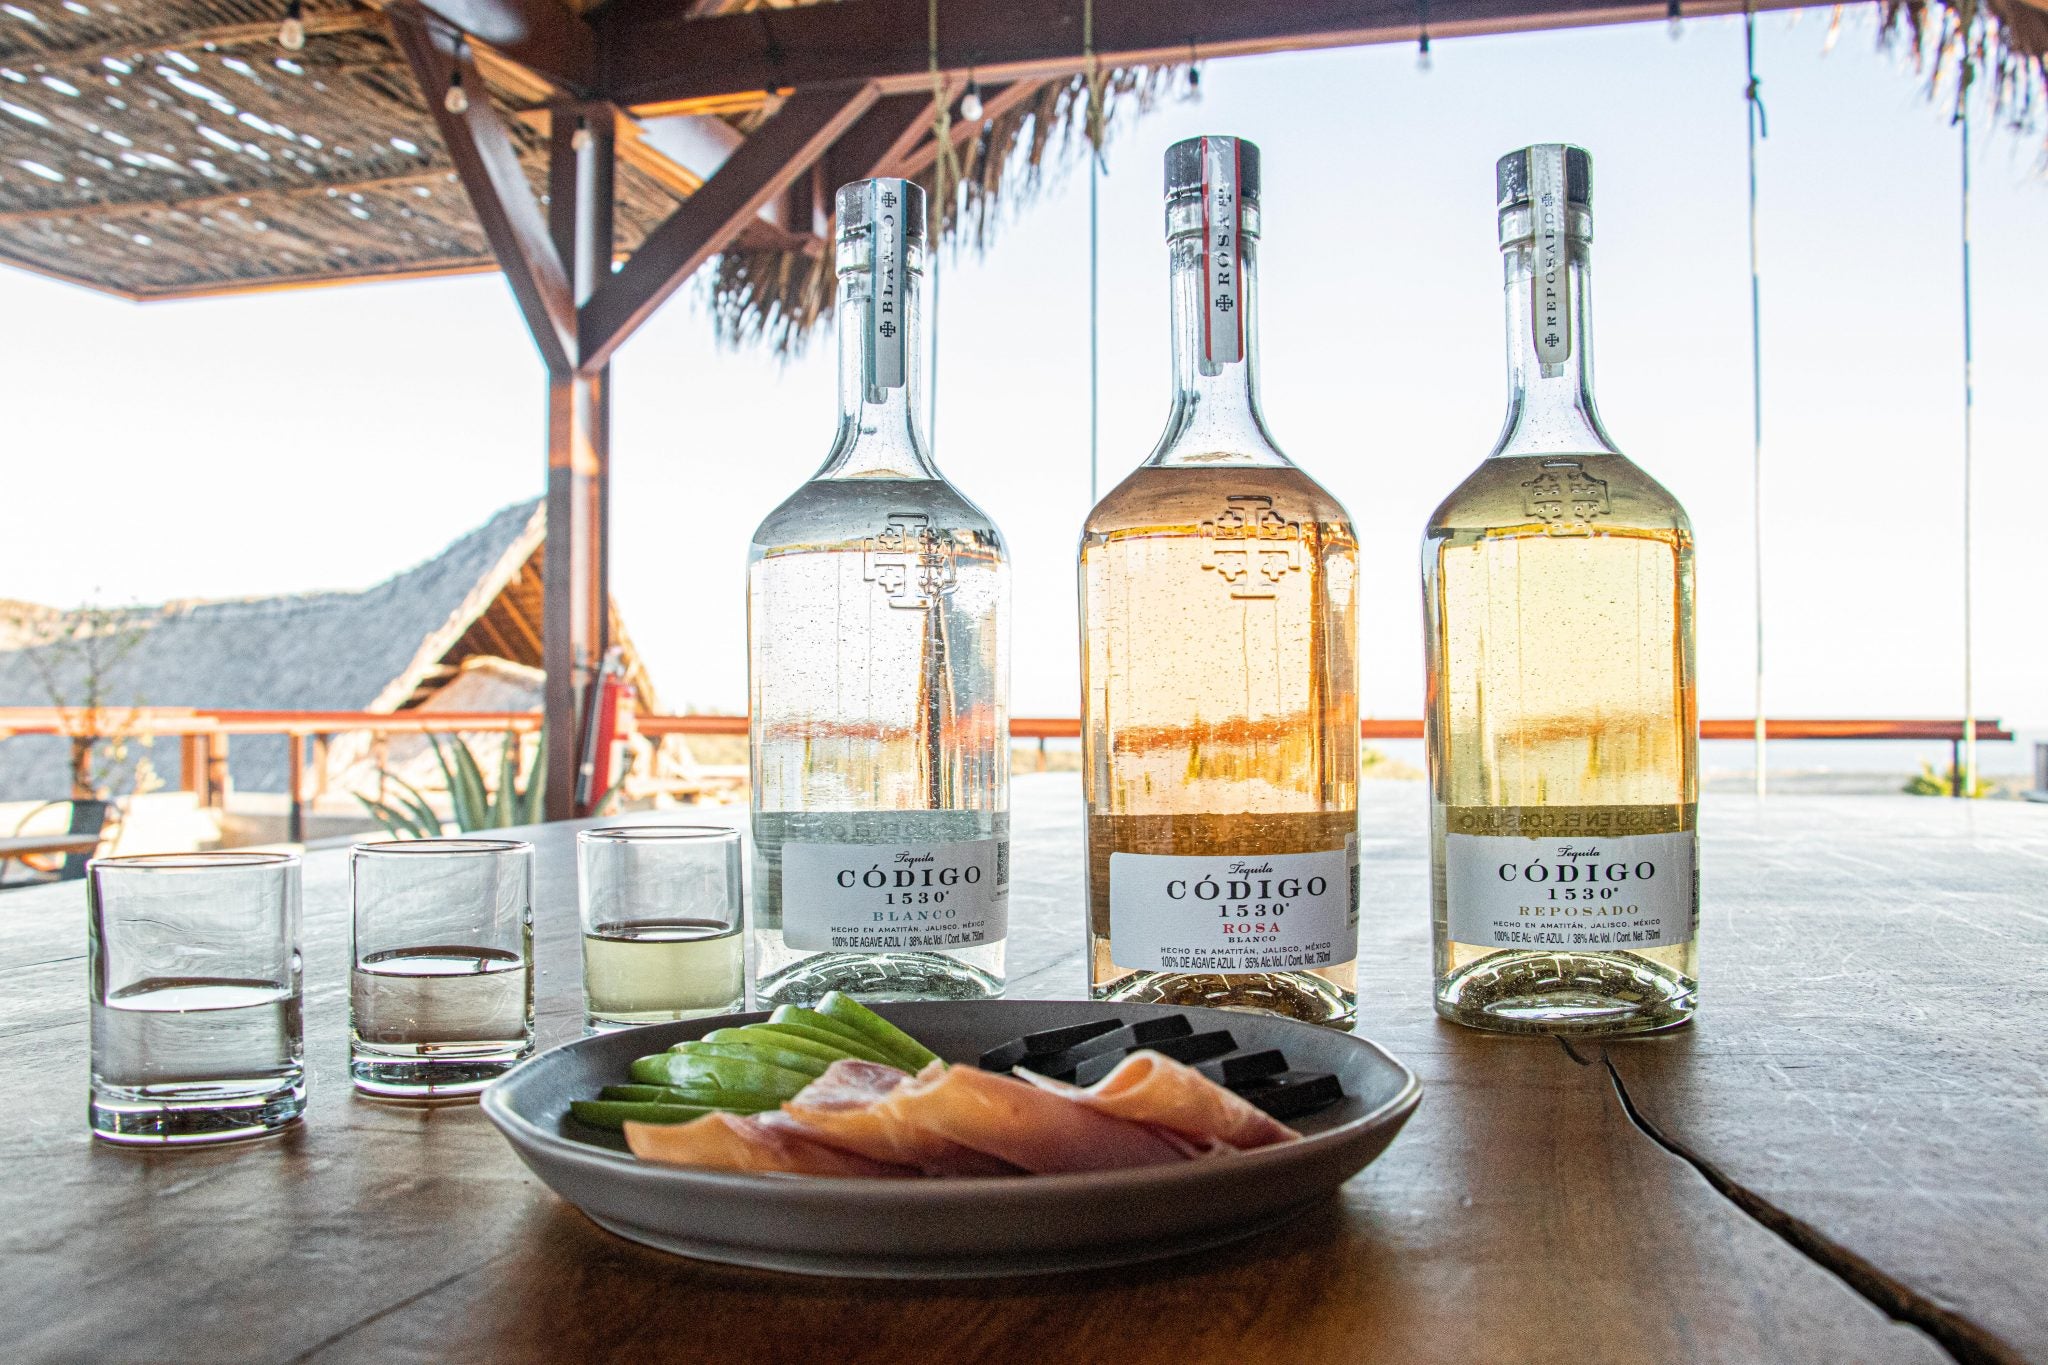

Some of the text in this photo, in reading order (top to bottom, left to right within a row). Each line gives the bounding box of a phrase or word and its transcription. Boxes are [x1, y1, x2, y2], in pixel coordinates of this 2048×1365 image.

[1545, 212, 1557, 326] REPOSADO
[894, 851, 935, 868] Tequila
[1556, 845, 1601, 863] Tequila
[836, 864, 982, 889] CÓDIGO
[1228, 860, 1274, 880] Tequila
[1499, 858, 1656, 883] CÓDIGO
[1166, 874, 1327, 900] CÓDIGO
[872, 909, 956, 922] BLANCO
[1519, 904, 1640, 917] REPOSADO
[963, 920, 985, 929] MÉXICO
[1222, 922, 1281, 934] ROSA
[1493, 920, 1521, 928] HECHO
[1634, 918, 1661, 927] MÉXICO
[832, 936, 848, 947] 100%
[849, 936, 859, 947] DE
[860, 936, 883, 948] AGAVE
[884, 936, 901, 947] AZUL
[909, 936, 922, 947] 38%
[1228, 935, 1277, 943] BLANCO
[1494, 931, 1510, 942] 100%
[1511, 931, 1521, 943] DE
[1546, 932, 1565, 944] AZUL
[1573, 933, 1588, 944] 38%
[1160, 947, 1191, 955] HECHO
[1305, 941, 1331, 951] MÉXICO
[1161, 956, 1179, 968] 100%
[1180, 956, 1190, 968] DE
[1191, 957, 1216, 968] AGAVE
[1217, 957, 1236, 969] AZUL
[1244, 957, 1260, 969] 35%
